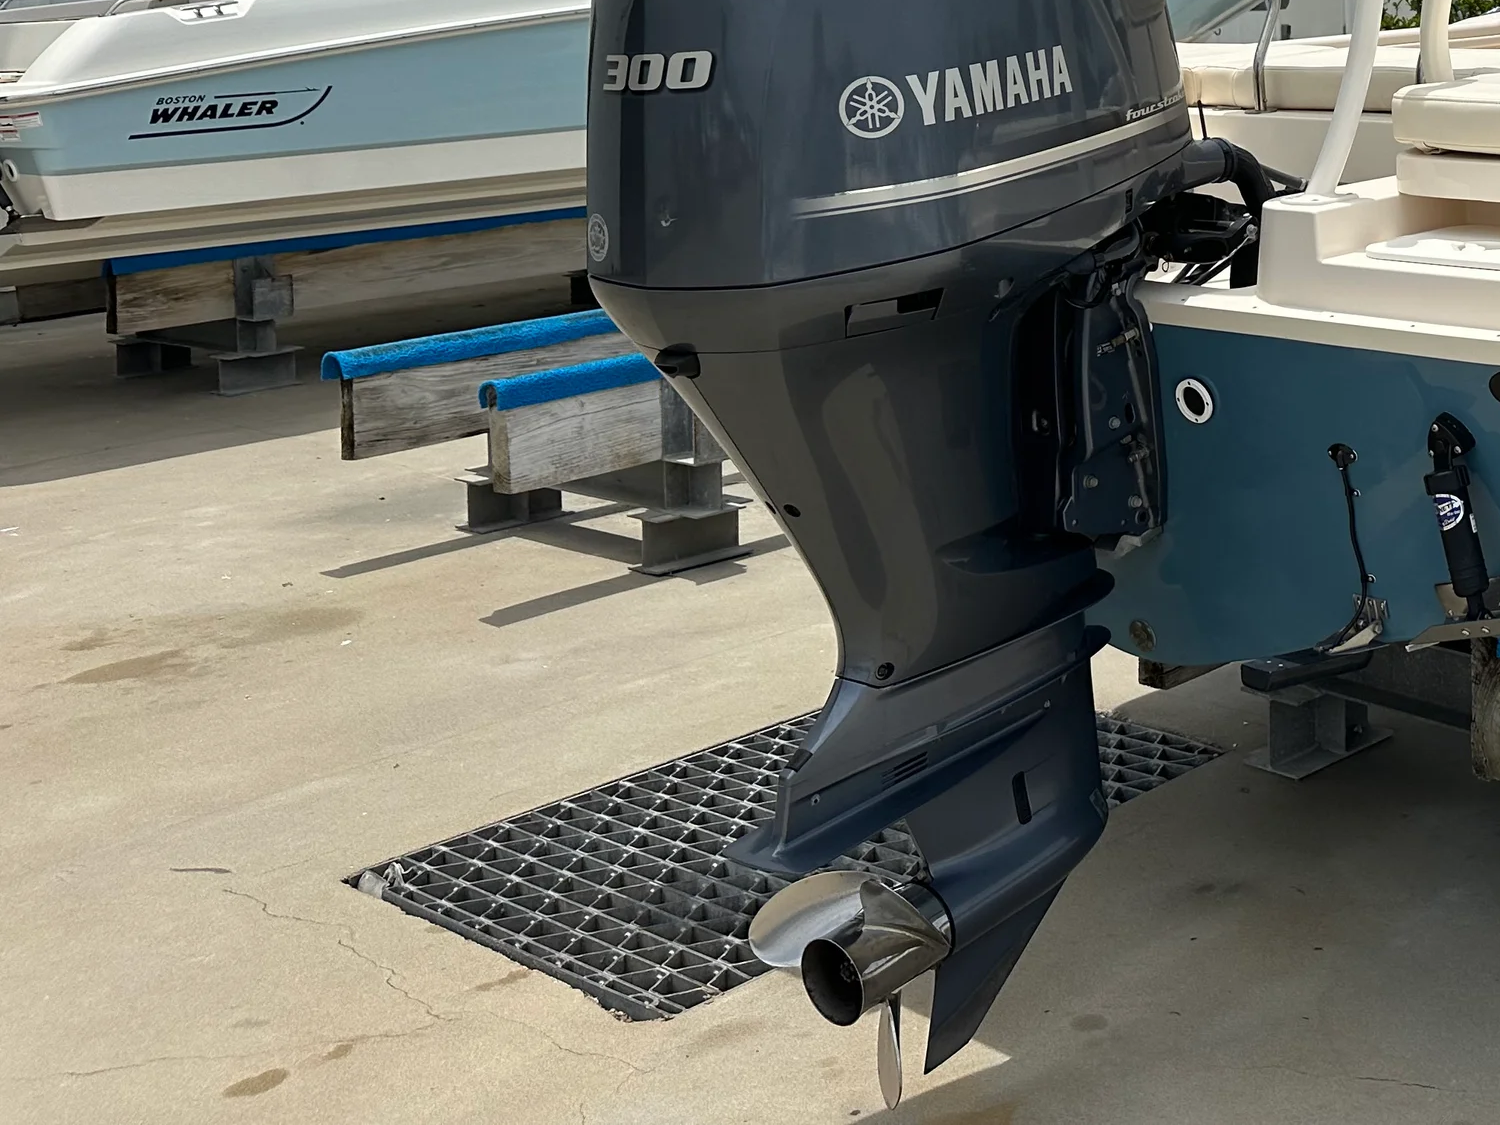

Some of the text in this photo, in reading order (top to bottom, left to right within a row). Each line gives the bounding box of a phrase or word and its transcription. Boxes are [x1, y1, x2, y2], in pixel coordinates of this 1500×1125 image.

[603, 50, 713, 91] 300
[905, 45, 1073, 126] YAMAHA
[149, 100, 278, 124] WHALER
[156, 95, 206, 106] BOSTON
